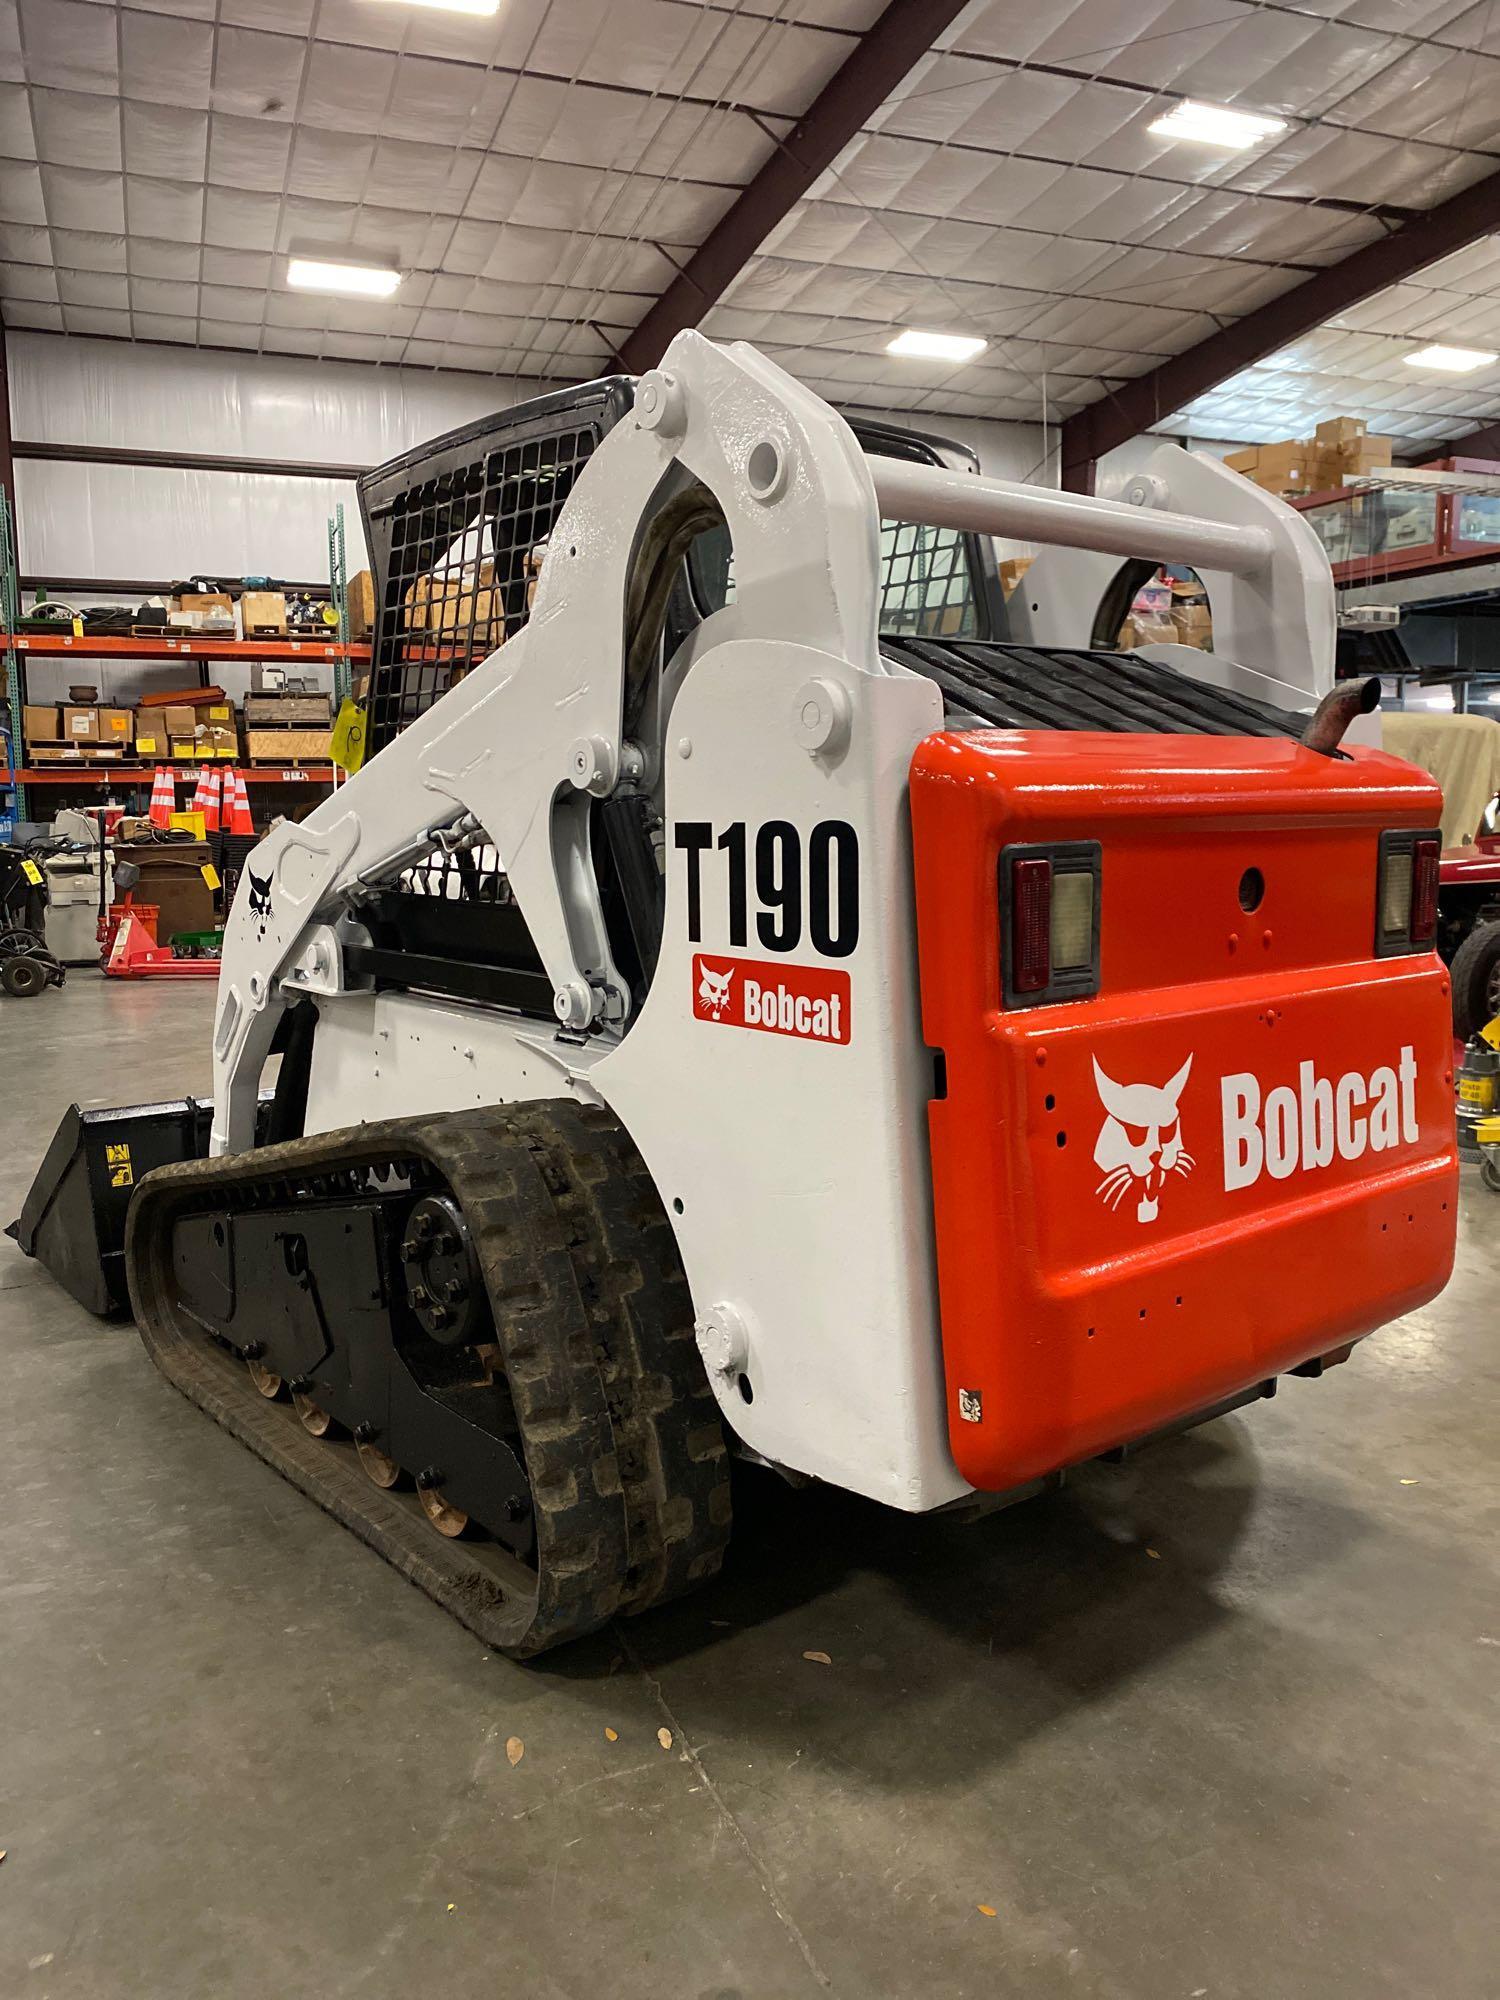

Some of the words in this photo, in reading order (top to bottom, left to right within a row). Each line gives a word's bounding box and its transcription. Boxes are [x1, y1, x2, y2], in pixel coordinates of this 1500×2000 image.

[675, 820, 859, 957] T190
[744, 979, 841, 1039] Bobcat
[1221, 1045, 1419, 1192] Bobcat
